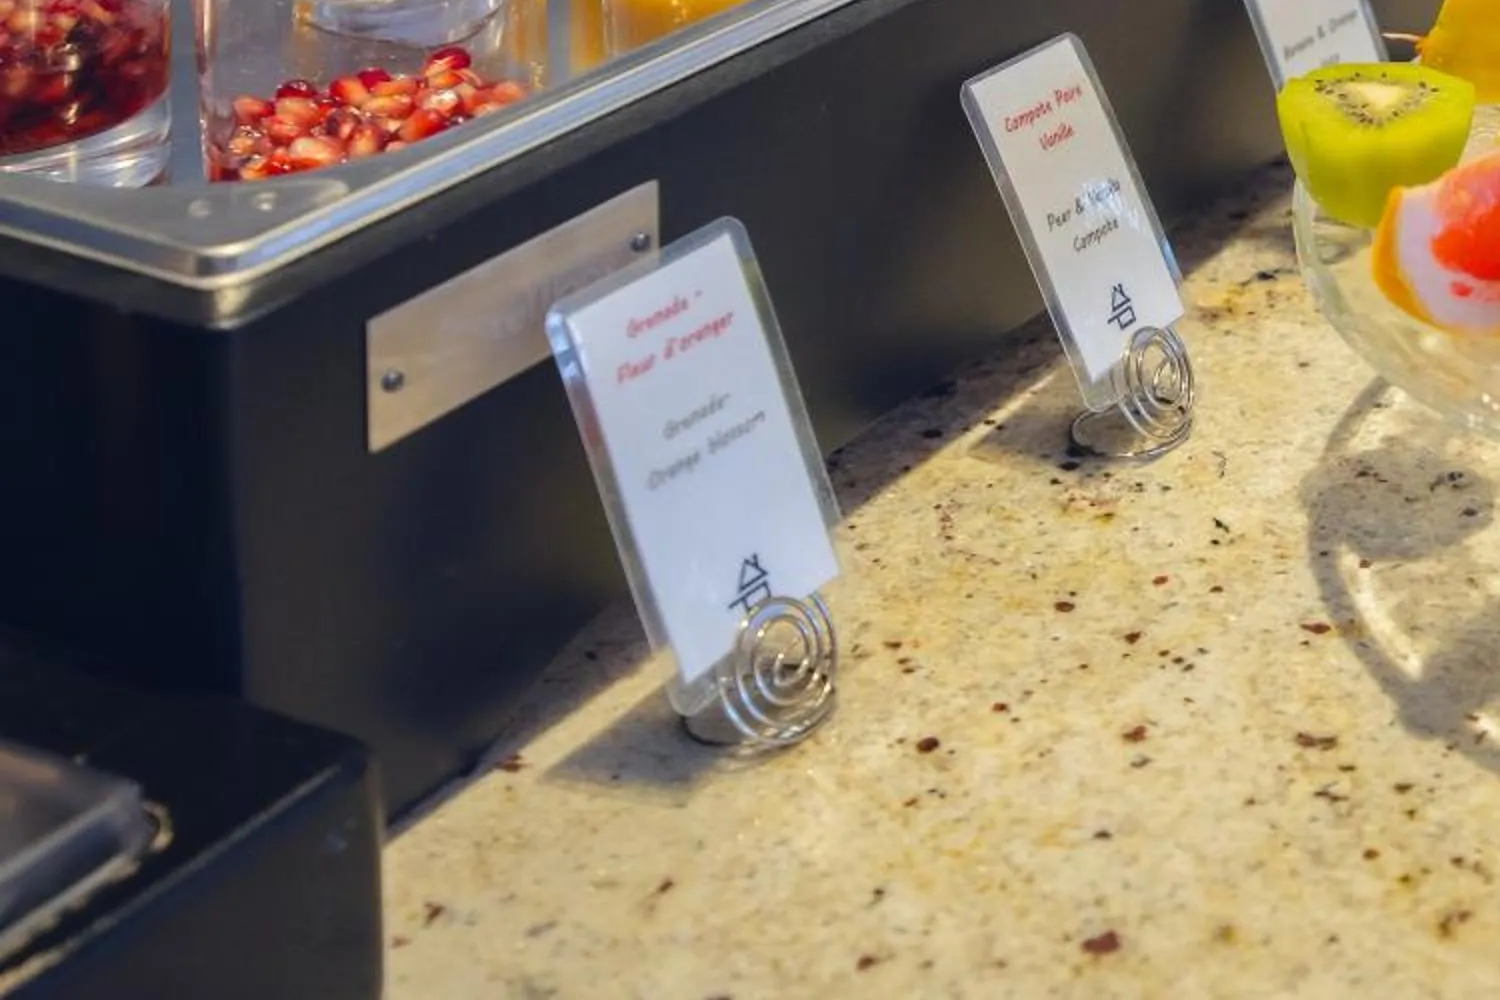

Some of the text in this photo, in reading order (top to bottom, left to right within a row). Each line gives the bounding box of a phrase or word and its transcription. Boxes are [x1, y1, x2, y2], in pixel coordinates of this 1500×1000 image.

[1004, 101, 1052, 132] Compote
[1073, 218, 1119, 252] Compote
[626, 297, 688, 338] Grenade
